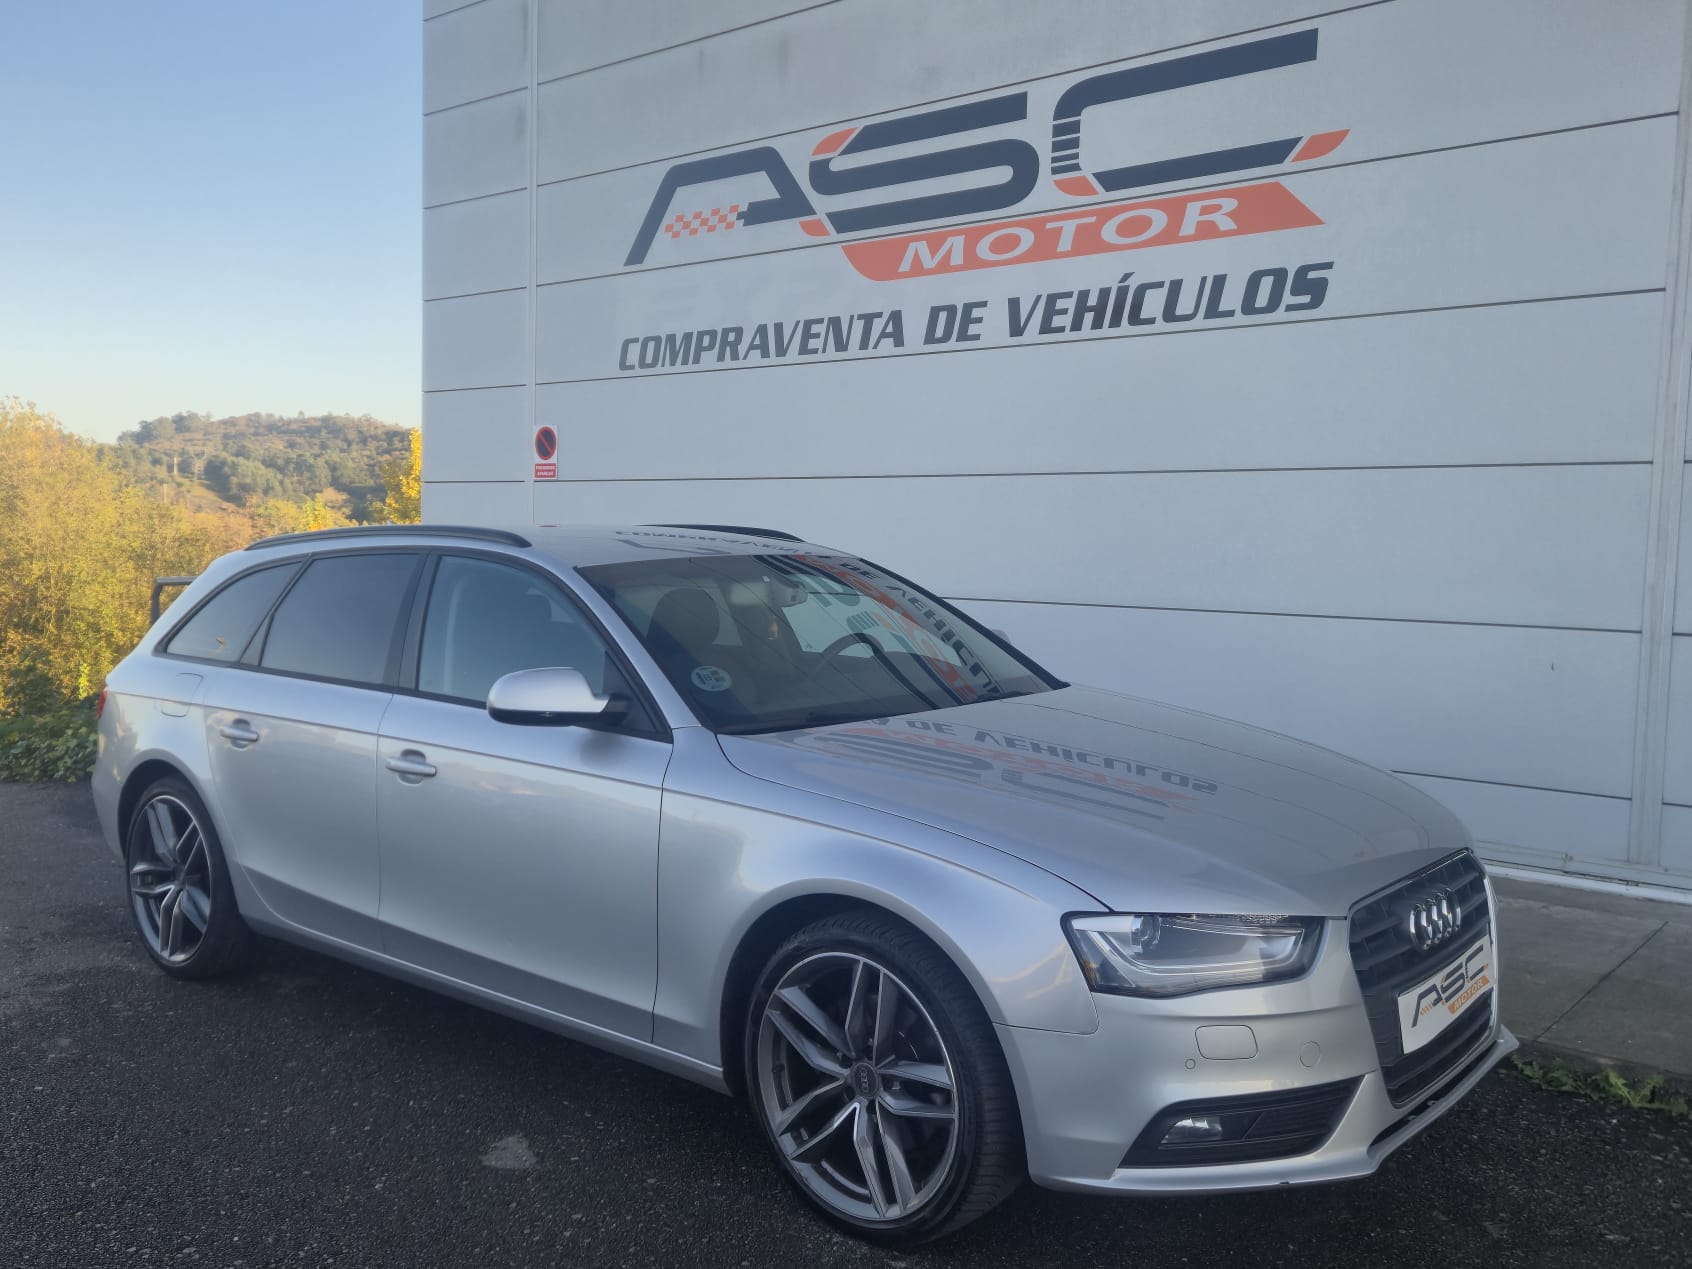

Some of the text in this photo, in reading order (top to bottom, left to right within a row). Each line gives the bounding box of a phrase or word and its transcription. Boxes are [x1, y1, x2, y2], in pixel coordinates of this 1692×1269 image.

[624, 28, 1350, 266] ASC
[898, 197, 1239, 273] MOTOR
[619, 261, 1334, 371] COMPRAVENTA DE VEHÍCULOS
[1412, 944, 1489, 1028] ASC
[1454, 979, 1483, 1010] MOTOR
